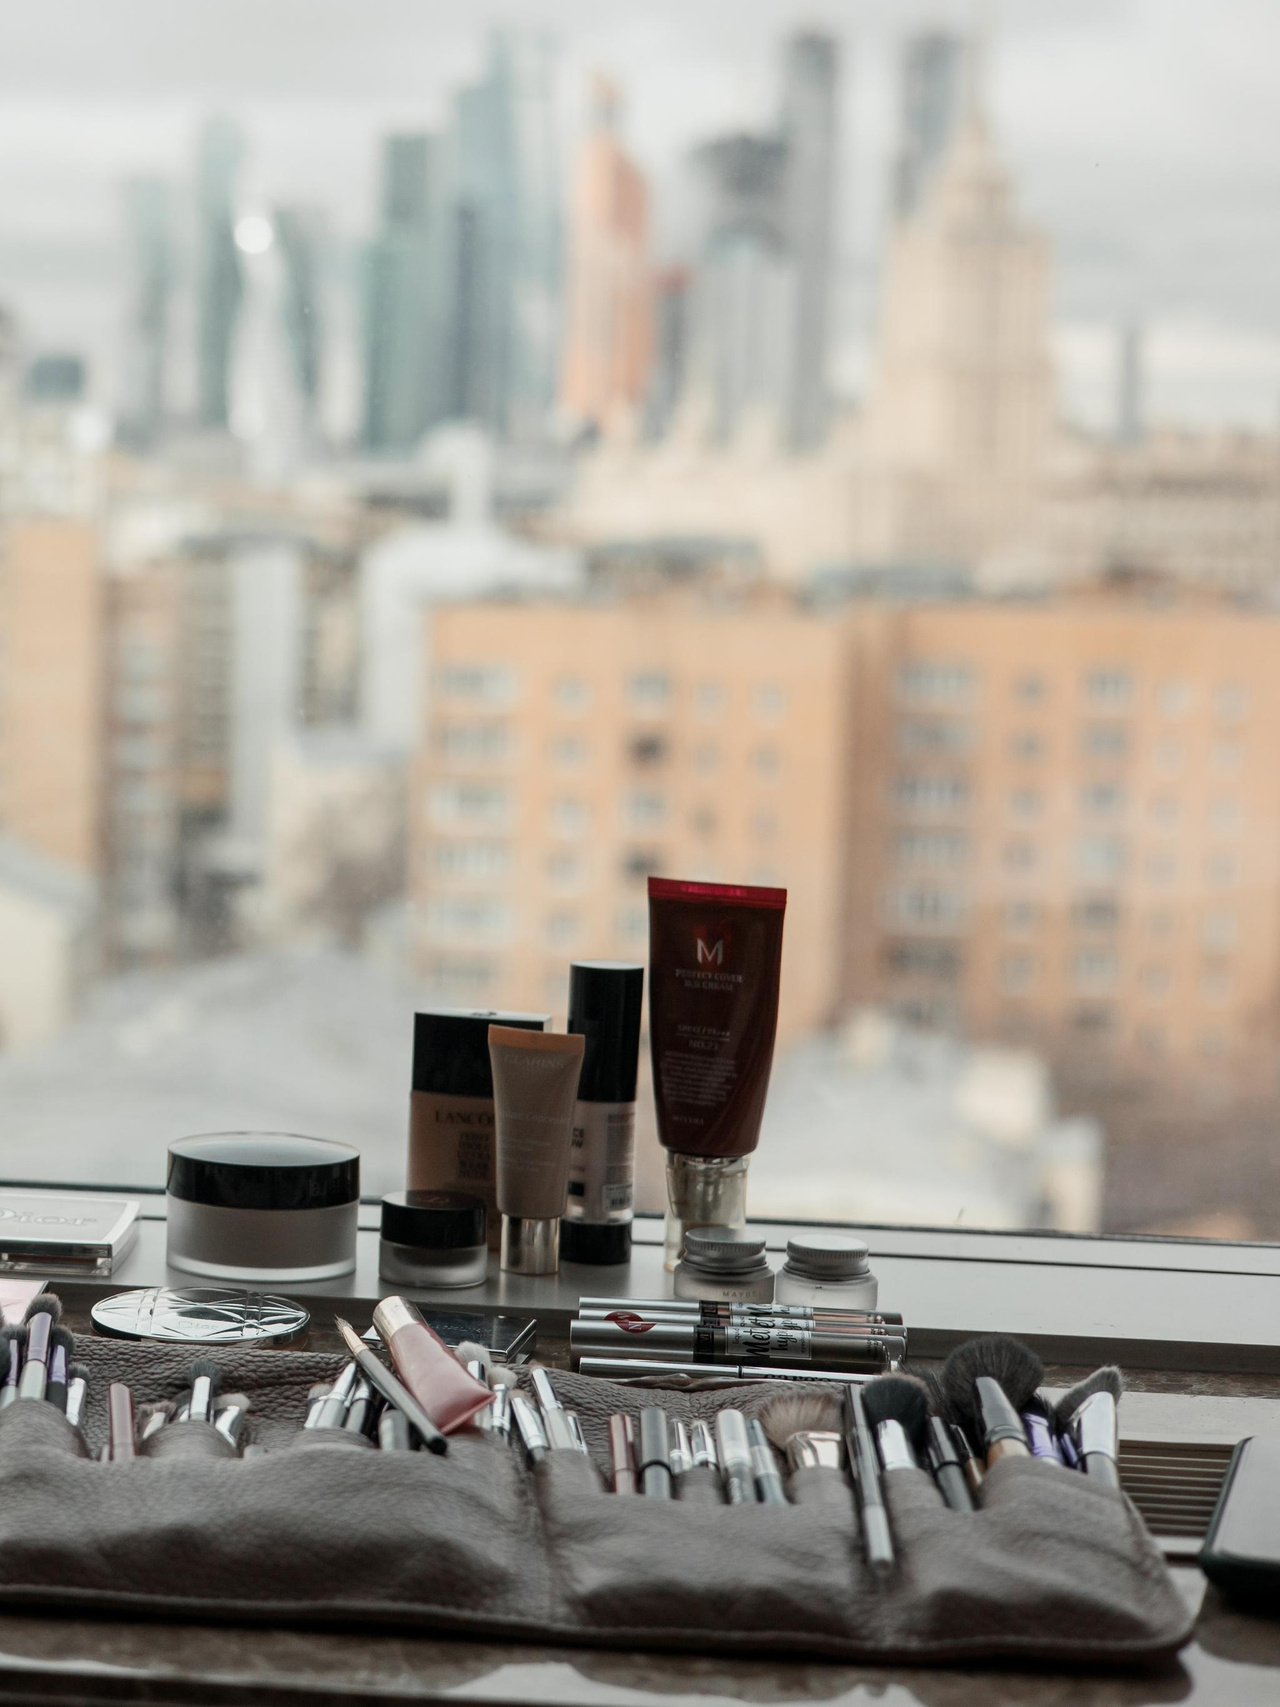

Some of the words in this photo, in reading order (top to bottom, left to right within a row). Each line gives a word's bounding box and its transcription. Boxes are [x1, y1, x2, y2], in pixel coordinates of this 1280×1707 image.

[696, 938, 724, 965] M
[714, 972, 743, 983] COVER
[176, 1320, 219, 1331] Dior
[742, 1328, 771, 1356] Met
